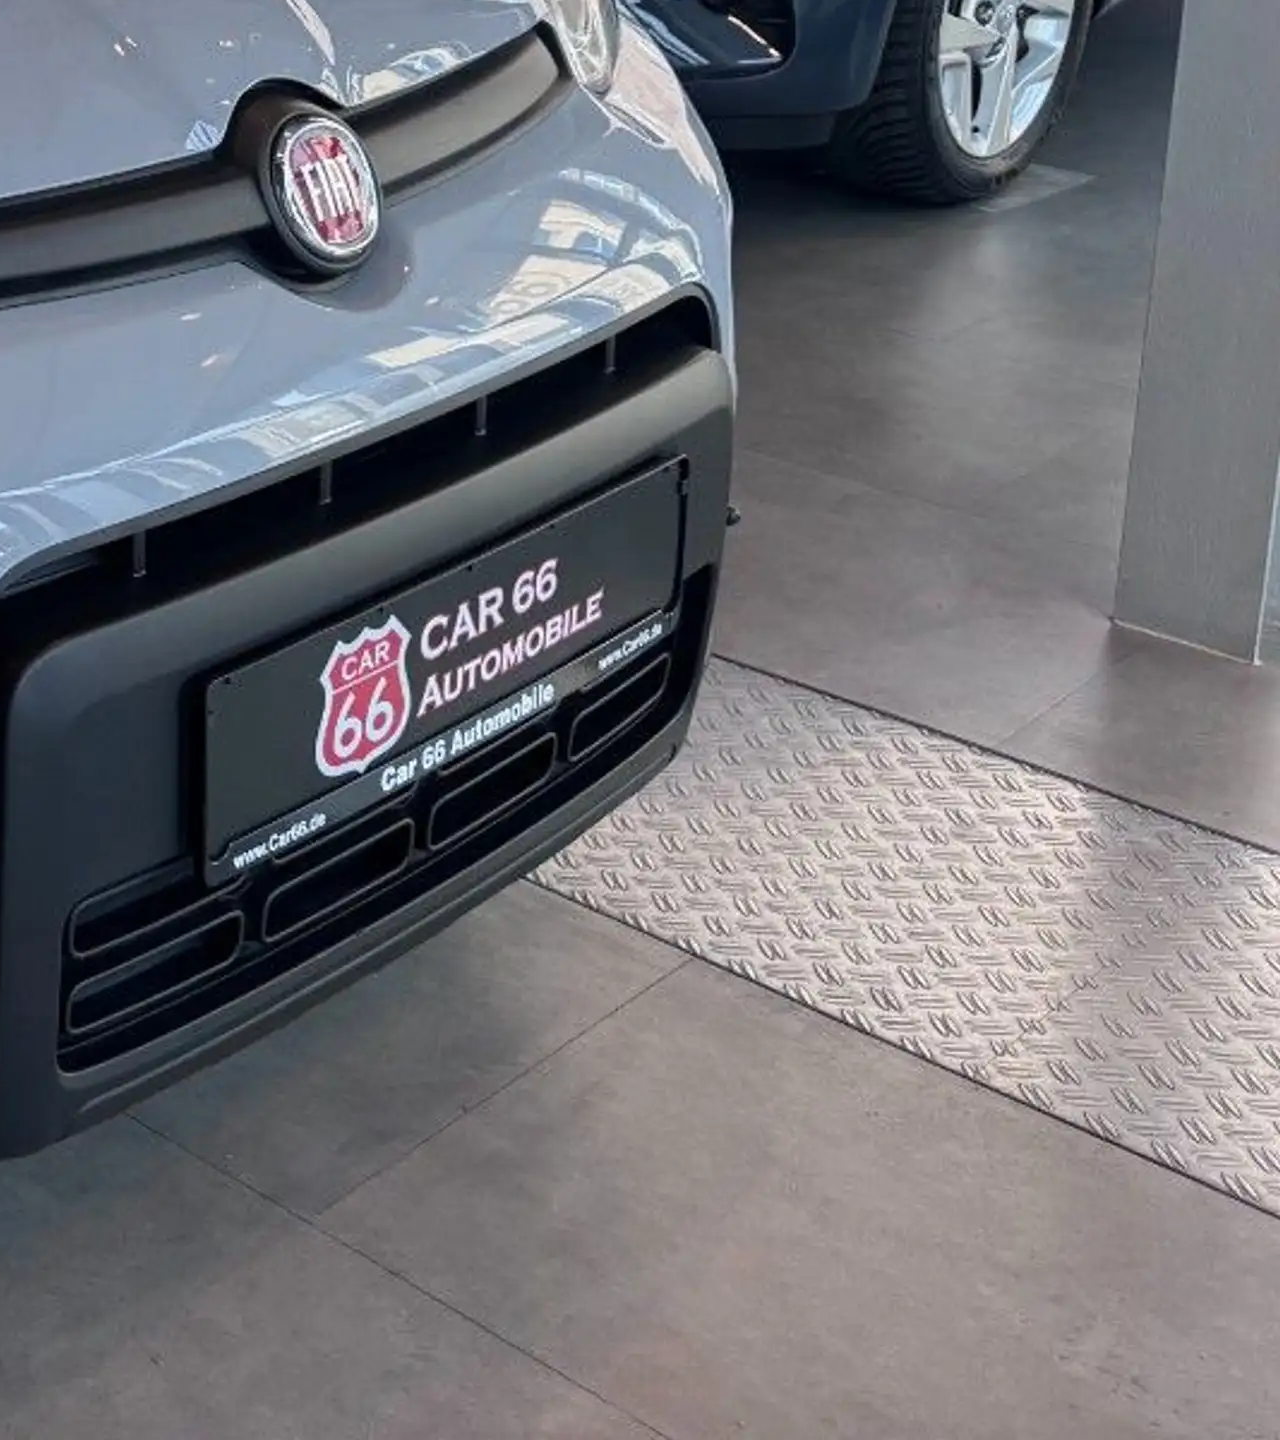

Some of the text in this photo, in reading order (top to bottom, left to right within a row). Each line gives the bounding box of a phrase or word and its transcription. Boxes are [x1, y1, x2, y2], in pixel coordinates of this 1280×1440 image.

[416, 587, 605, 718] AUTOMOBILE
[420, 557, 559, 661] CAR 66
[340, 640, 391, 681] CAR
[333, 677, 395, 759] 66
[380, 683, 555, 792] Car 66 Automobile
[232, 812, 327, 870] www.Car66.de
